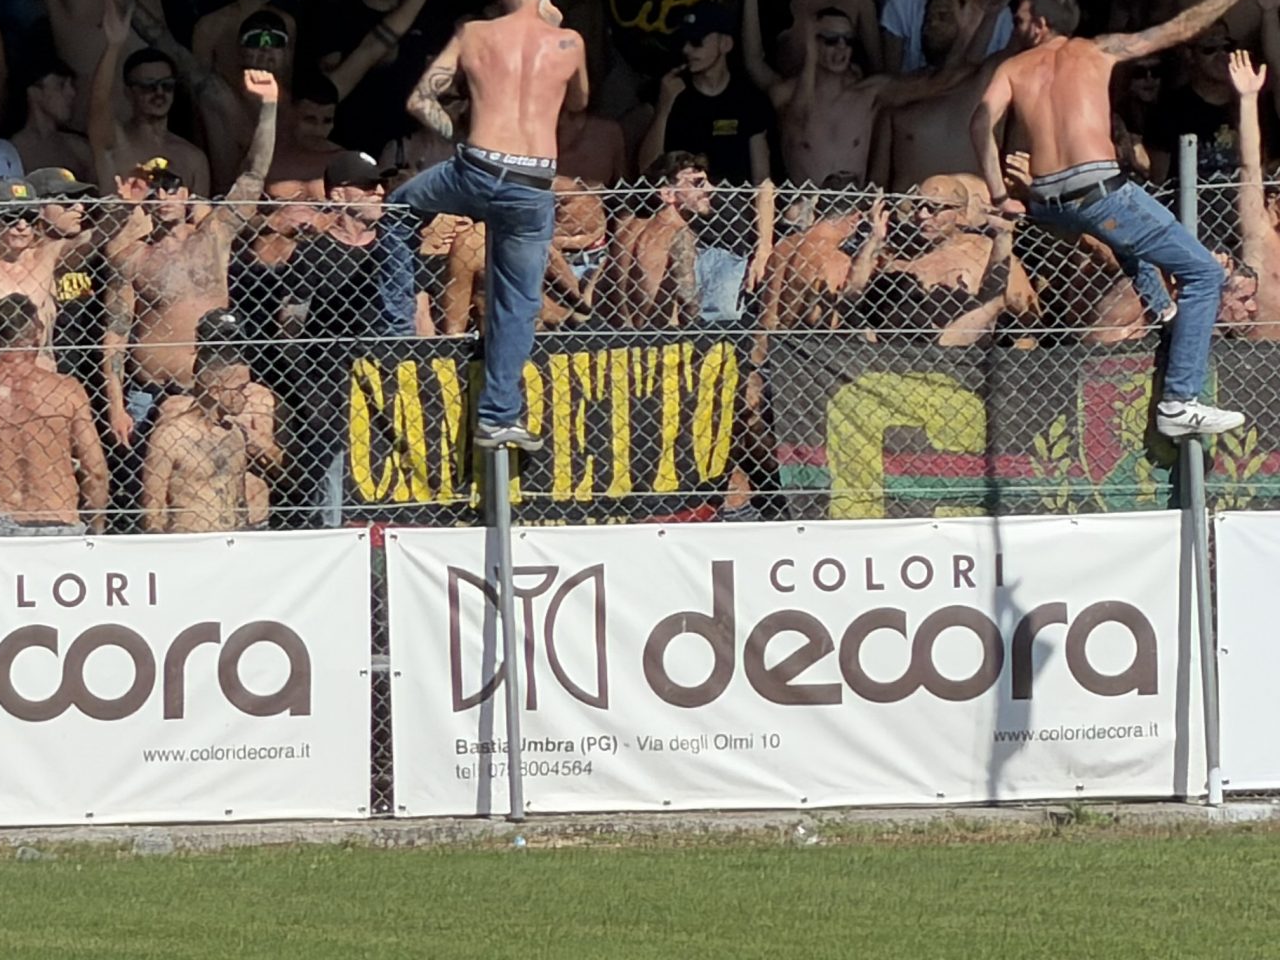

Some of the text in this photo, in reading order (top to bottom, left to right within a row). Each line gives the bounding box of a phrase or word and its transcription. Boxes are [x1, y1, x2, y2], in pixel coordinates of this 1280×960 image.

[769, 553, 1004, 593] COLORI
[643, 560, 1158, 709] decora
[993, 722, 1159, 742] www.coloridecora.it
[143, 743, 311, 762] www.coloridecora.it
[581, 735, 618, 756] (PG)
[637, 735, 663, 752] Via
[669, 734, 708, 754] degli
[714, 733, 753, 751] Olmi
[762, 733, 781, 749] 10
[487, 761, 509, 779] 07
